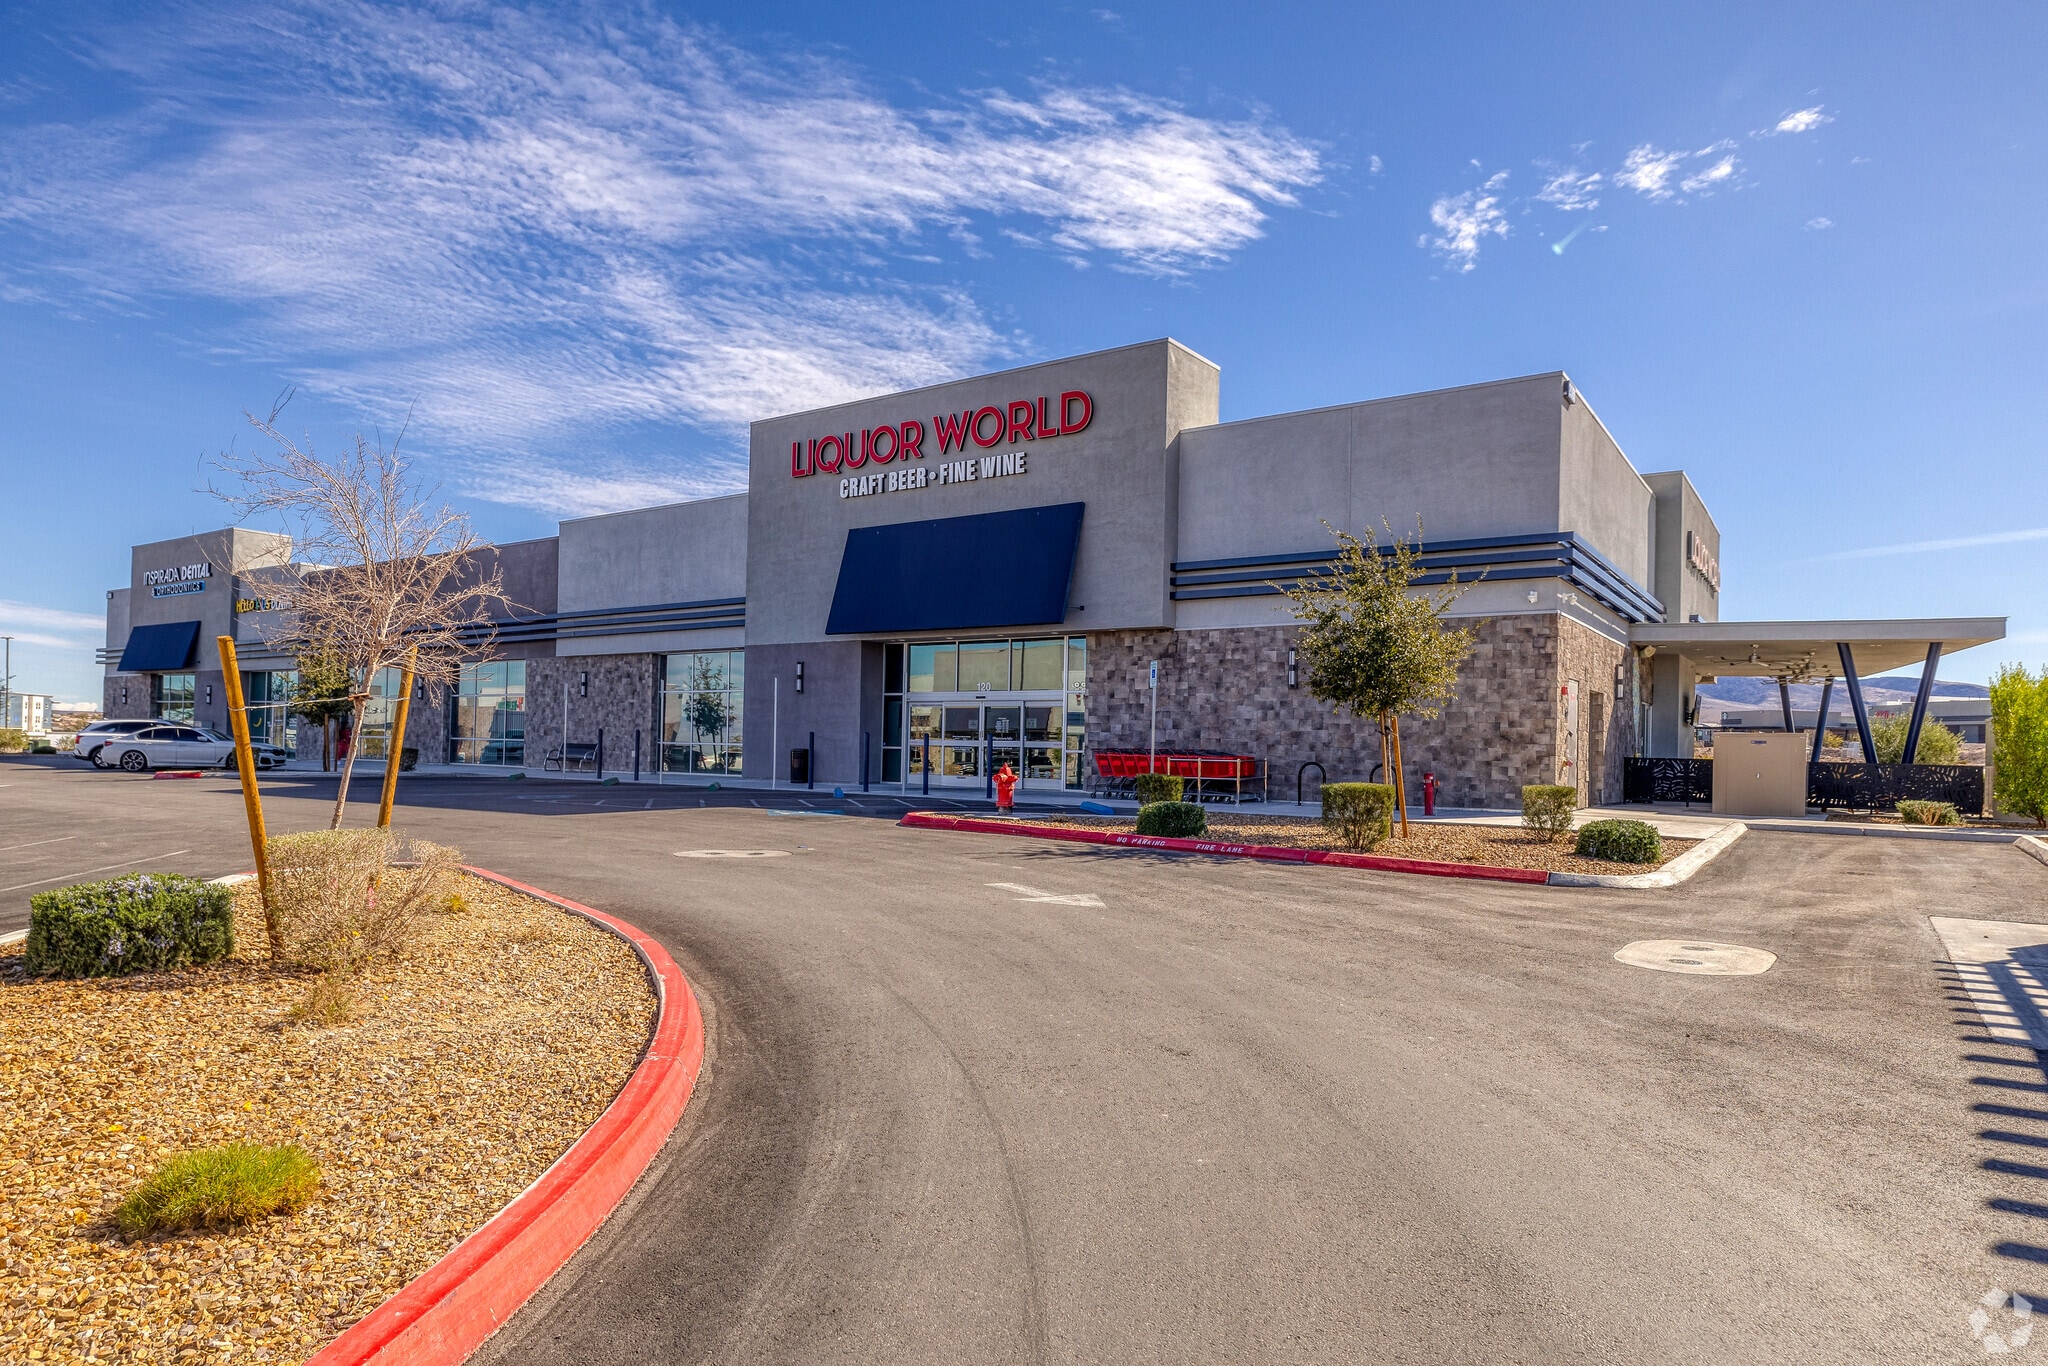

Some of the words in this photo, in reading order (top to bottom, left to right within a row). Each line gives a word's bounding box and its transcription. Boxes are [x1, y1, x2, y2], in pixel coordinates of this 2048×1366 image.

[791, 420, 923, 477] LIQUOR
[932, 389, 1094, 454] WORLD
[839, 472, 886, 498] CRAFT
[888, 467, 927, 492] BEER
[939, 459, 976, 485] FINE
[980, 452, 1027, 479] WINE
[157, 581, 201, 596] ORTHODONTICS
[235, 598, 255, 613] HELLO
[976, 682, 991, 692] 120
[1131, 838, 1166, 847] PARKING
[1195, 843, 1216, 852] FIRE
